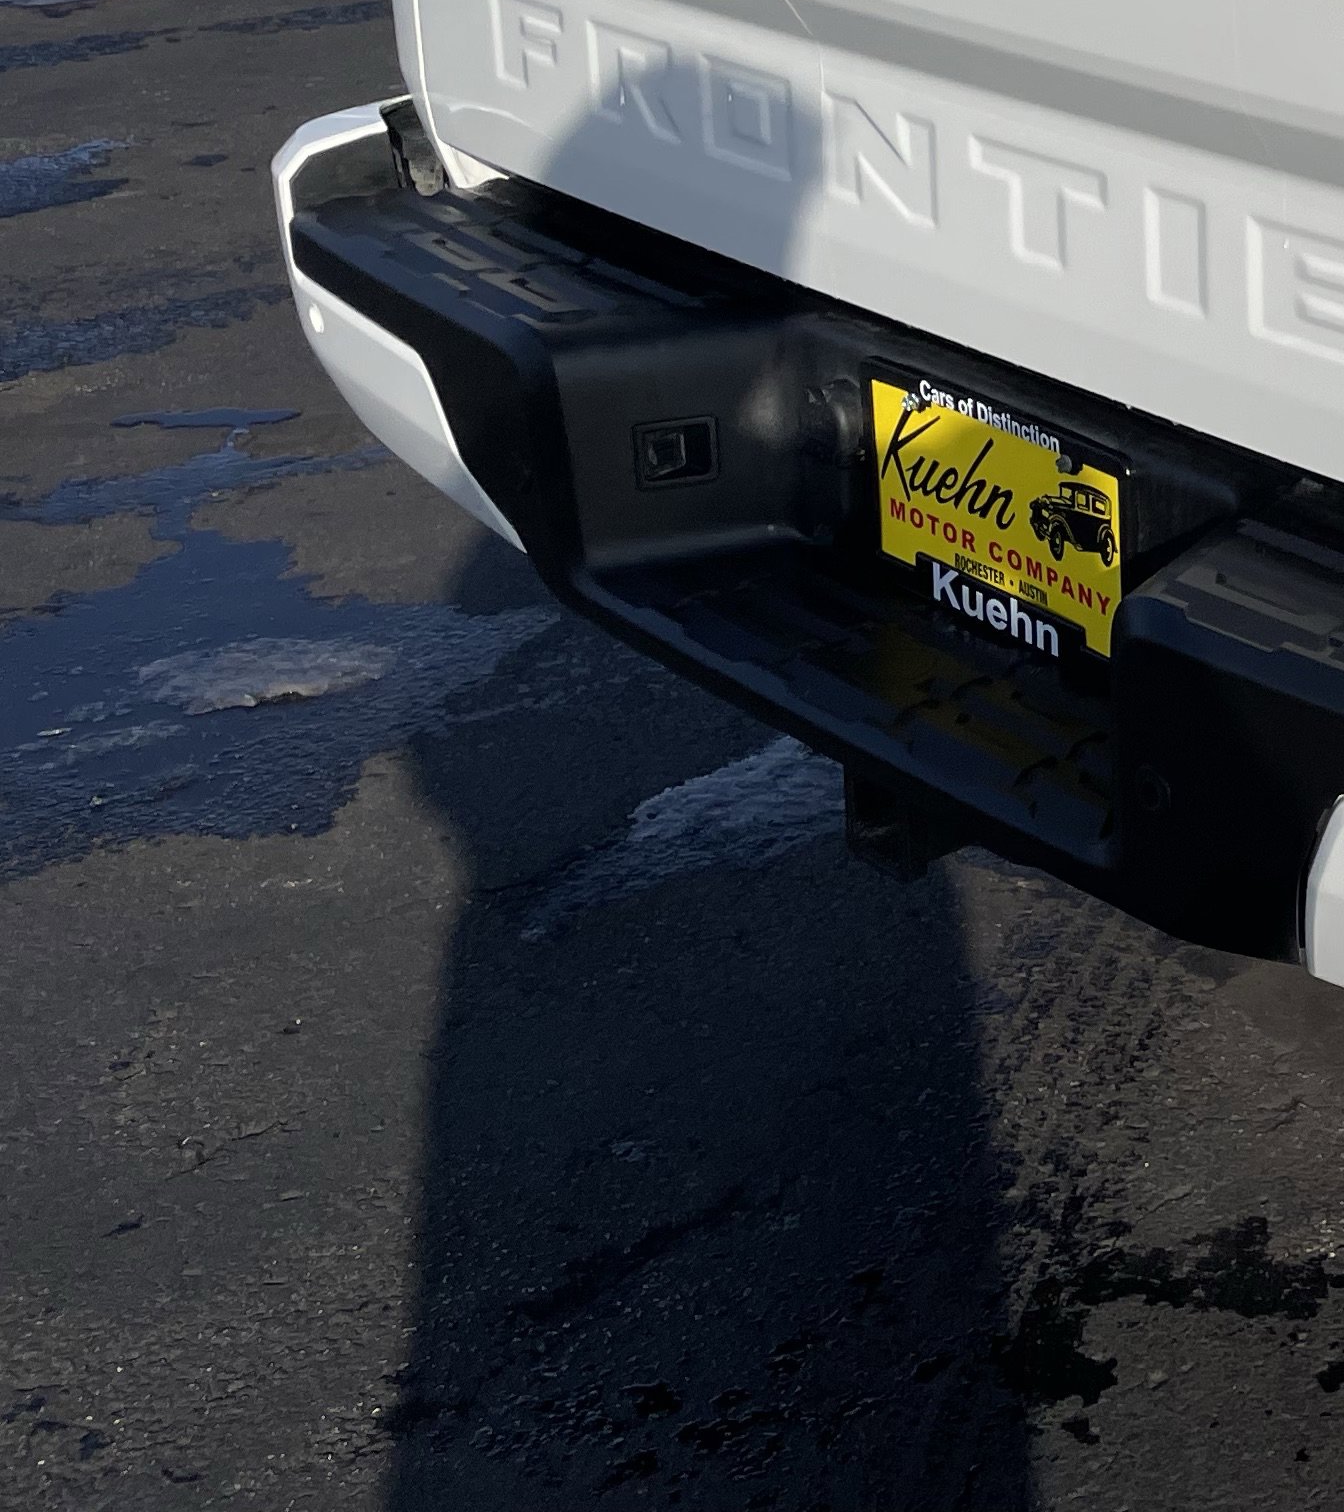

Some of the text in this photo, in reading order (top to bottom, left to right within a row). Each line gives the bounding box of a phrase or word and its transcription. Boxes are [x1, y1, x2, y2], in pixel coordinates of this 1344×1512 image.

[919, 379, 1061, 454] Cars of Distinction
[881, 407, 1016, 530] Kuehn
[890, 498, 1112, 617] MOTOR COMPANY
[954, 553, 1048, 606] ROCHESTER AUSTIN
[931, 560, 1060, 658] Kuehn
